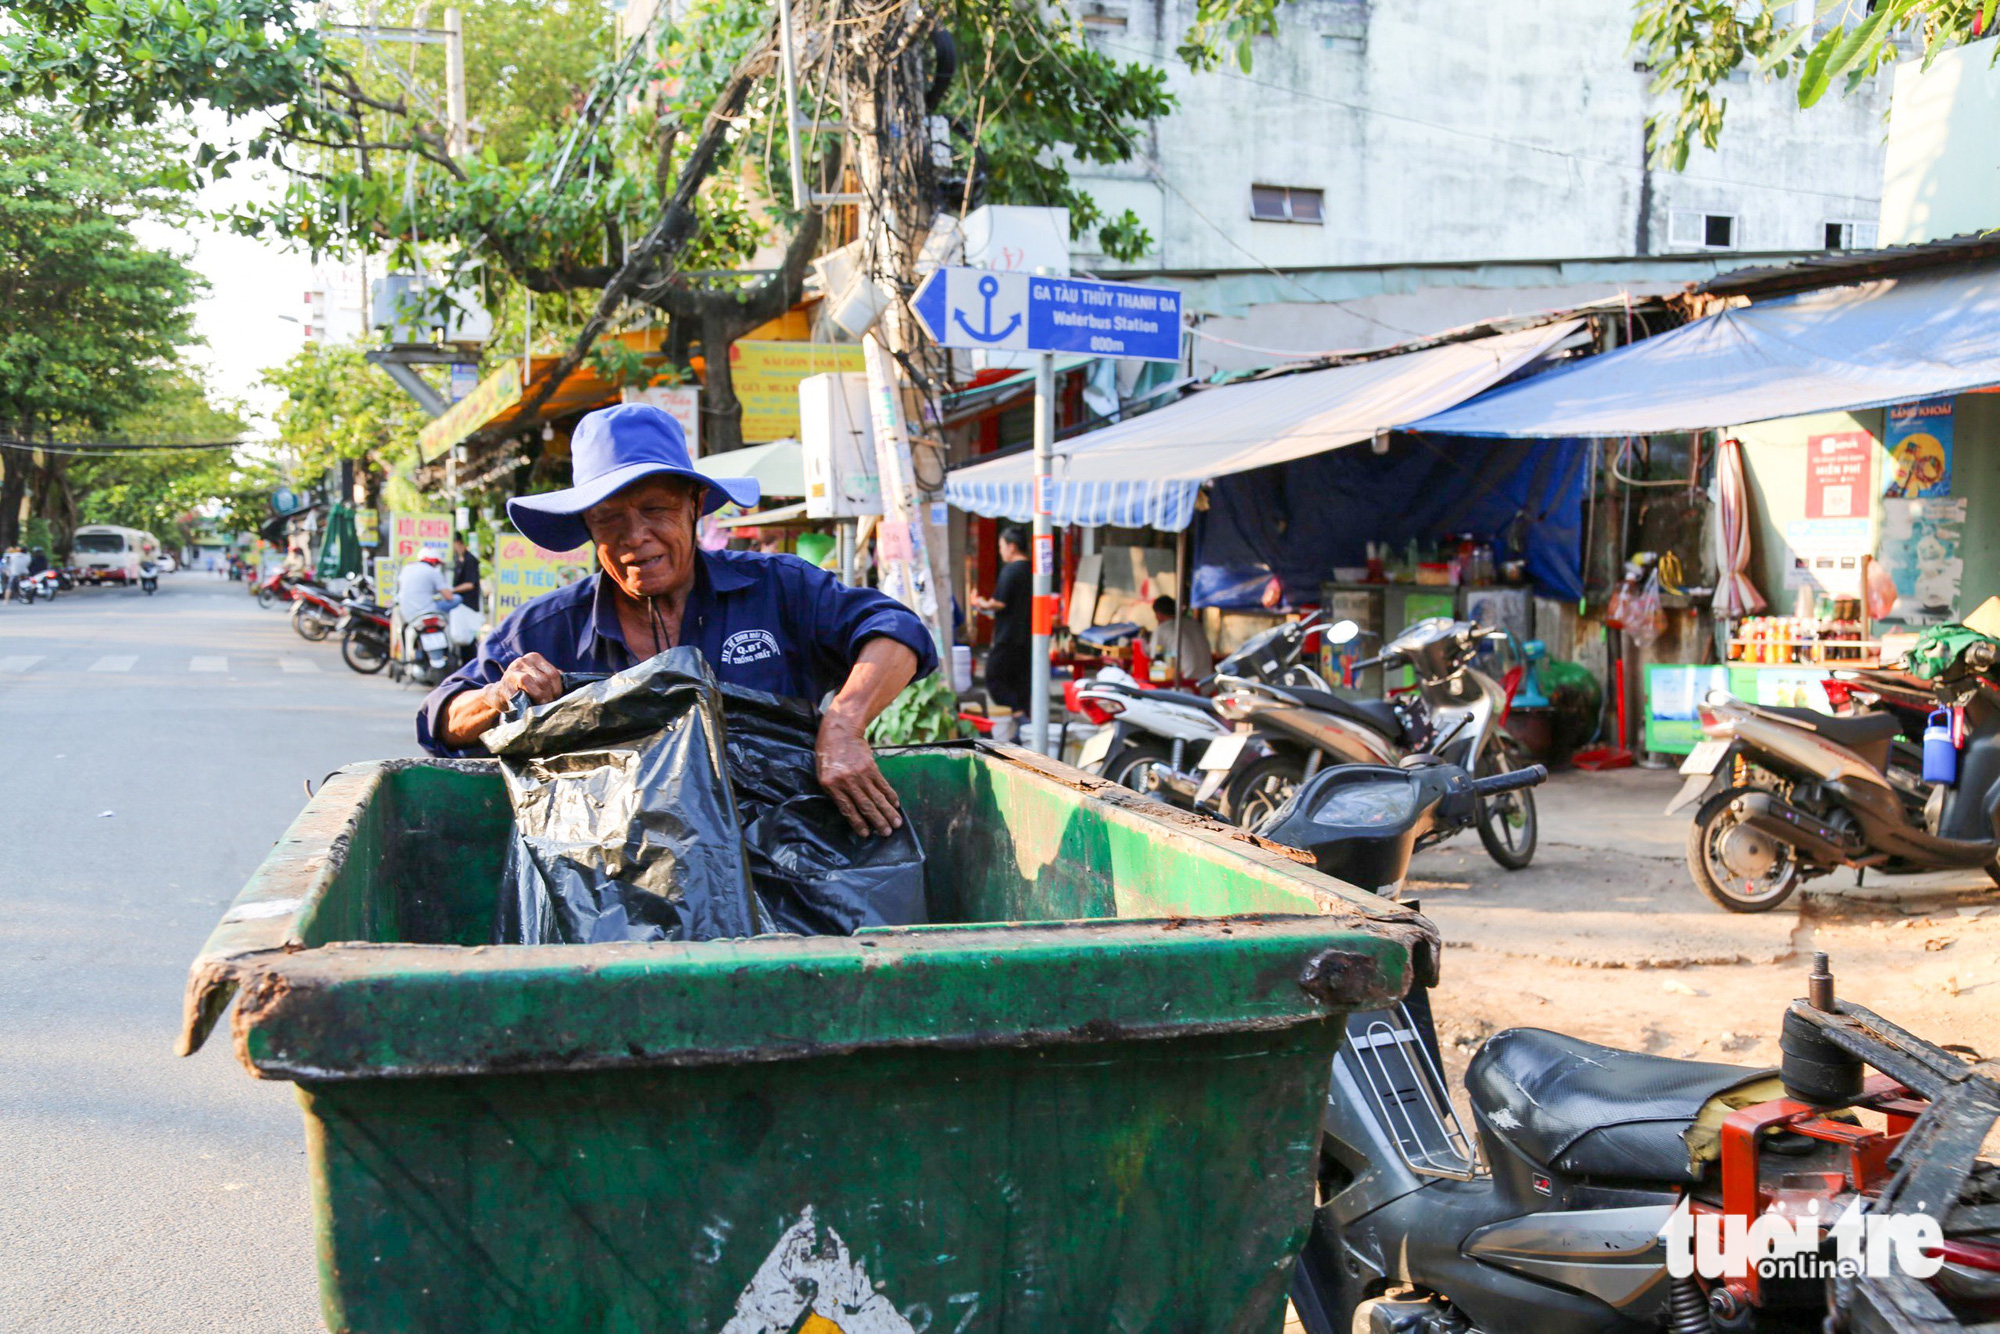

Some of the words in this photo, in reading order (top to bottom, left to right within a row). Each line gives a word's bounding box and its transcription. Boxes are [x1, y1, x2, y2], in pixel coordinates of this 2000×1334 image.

[1034, 285, 1050, 300] GA
[1054, 282, 1079, 303] TÀU
[1082, 286, 1114, 306] THỦY
[1117, 293, 1157, 310] THANH
[1160, 298, 1176, 313] ĐA
[1053, 310, 1112, 330] Waterbus
[1113, 315, 1158, 333] Station
[501, 563, 519, 585] HỦ
[524, 564, 555, 587] TIẾU
[736, 642, 761, 654] Q.BT
